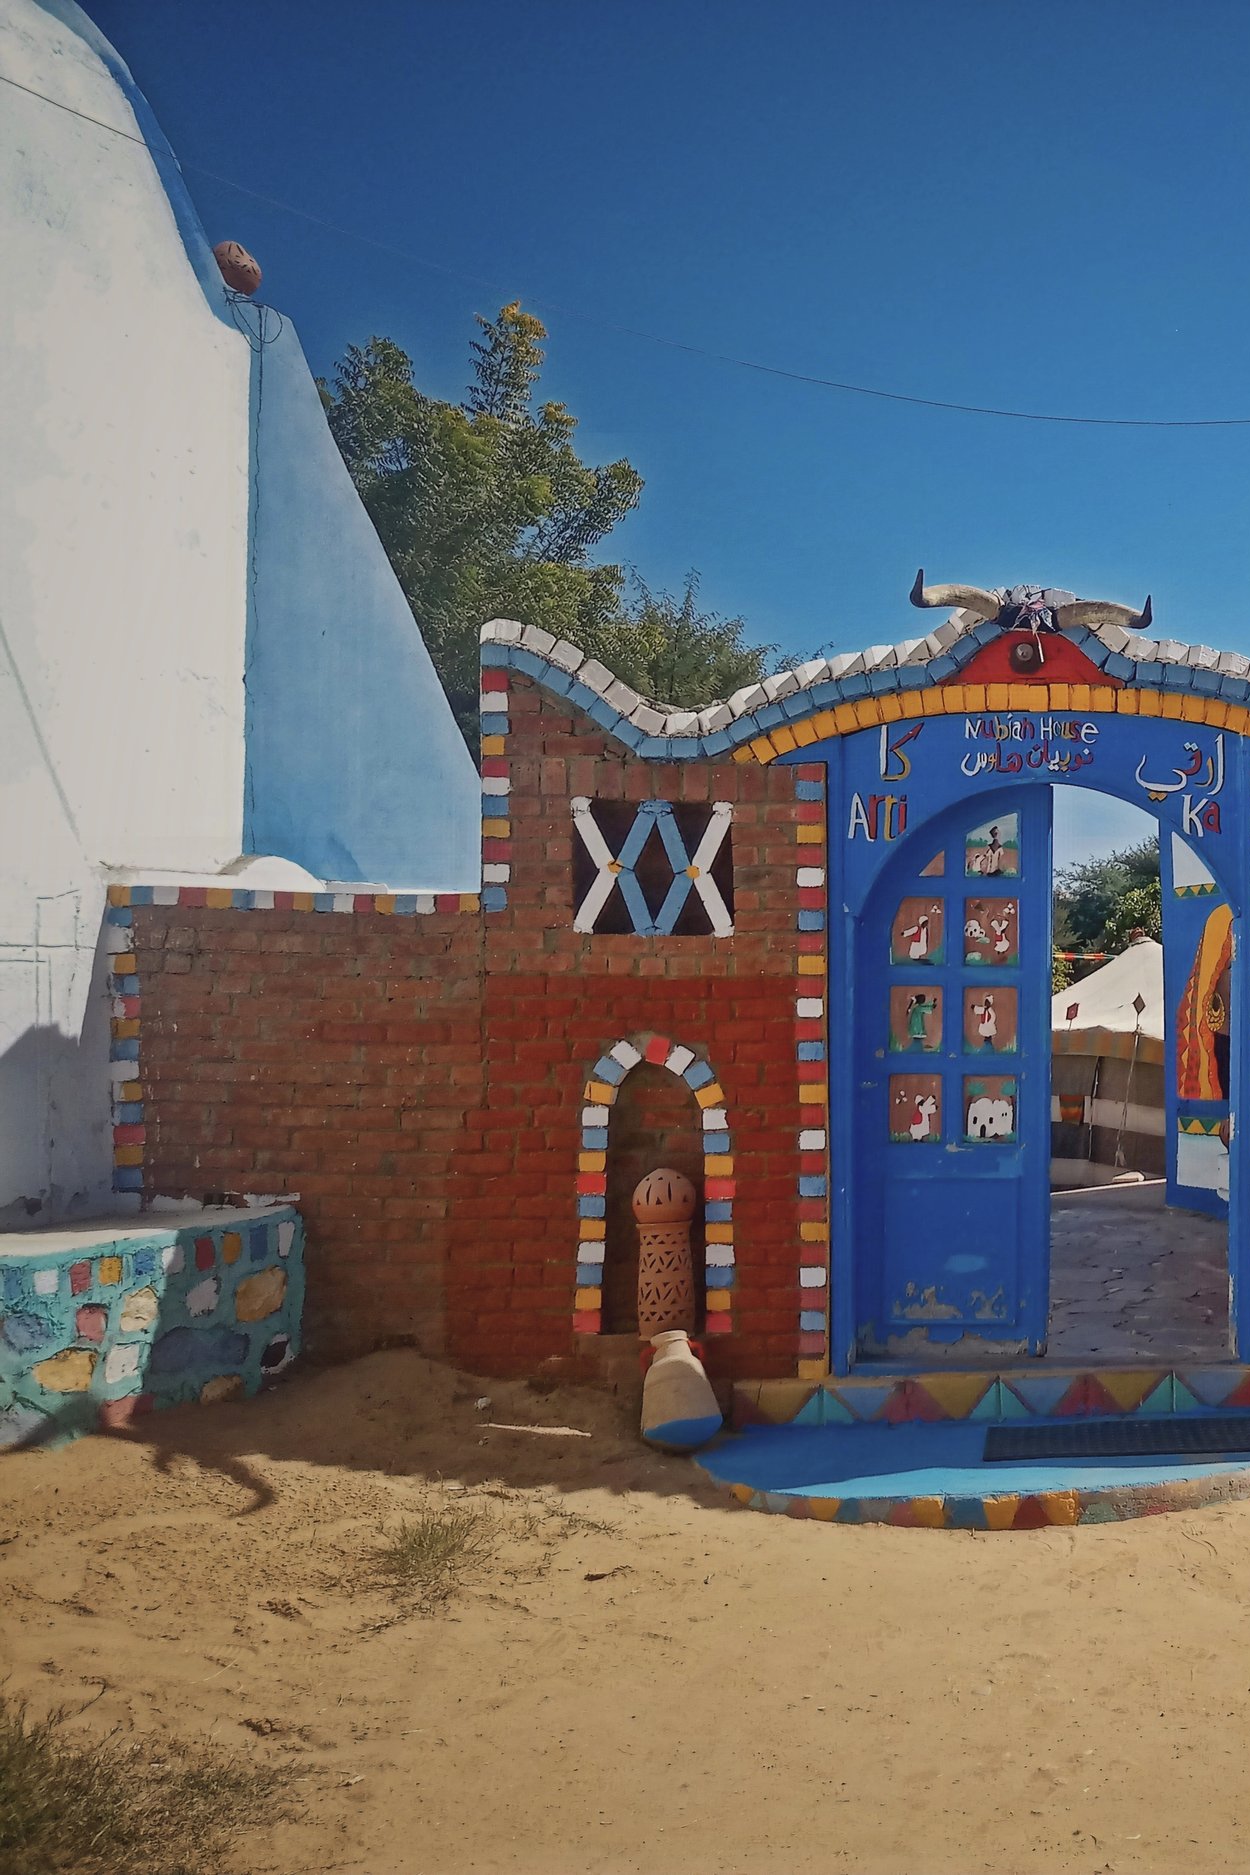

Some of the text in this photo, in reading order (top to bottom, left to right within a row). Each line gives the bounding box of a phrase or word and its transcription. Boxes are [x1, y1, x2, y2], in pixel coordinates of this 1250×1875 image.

[965, 713, 1100, 744] Nubian House
[960, 742, 1023, 776] هاوس
[847, 792, 908, 842] Arti
[1182, 794, 1221, 838] Ka
